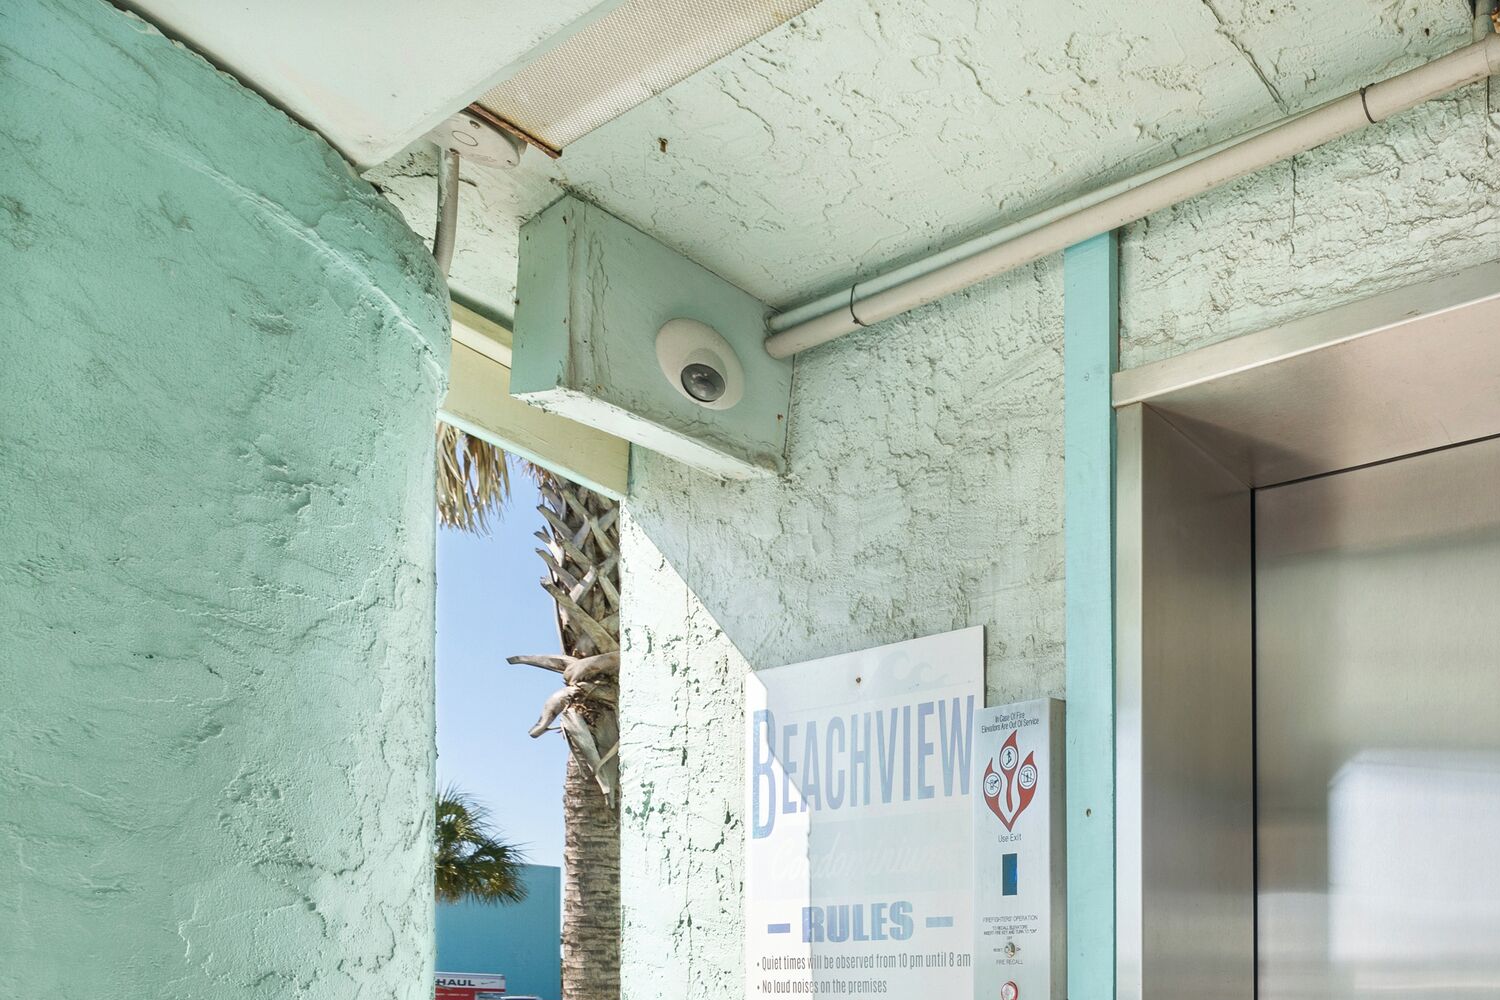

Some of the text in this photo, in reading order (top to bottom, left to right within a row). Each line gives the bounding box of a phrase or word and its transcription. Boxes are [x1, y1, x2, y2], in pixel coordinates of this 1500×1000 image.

[752, 695, 974, 840] BEACHVIEW
[1010, 833, 1022, 842] Exit
[801, 901, 914, 943] RULES
[762, 952, 971, 970] Quiet times will be observed from 10 pm until 8 am
[762, 978, 887, 994] No loud noises on the premises
